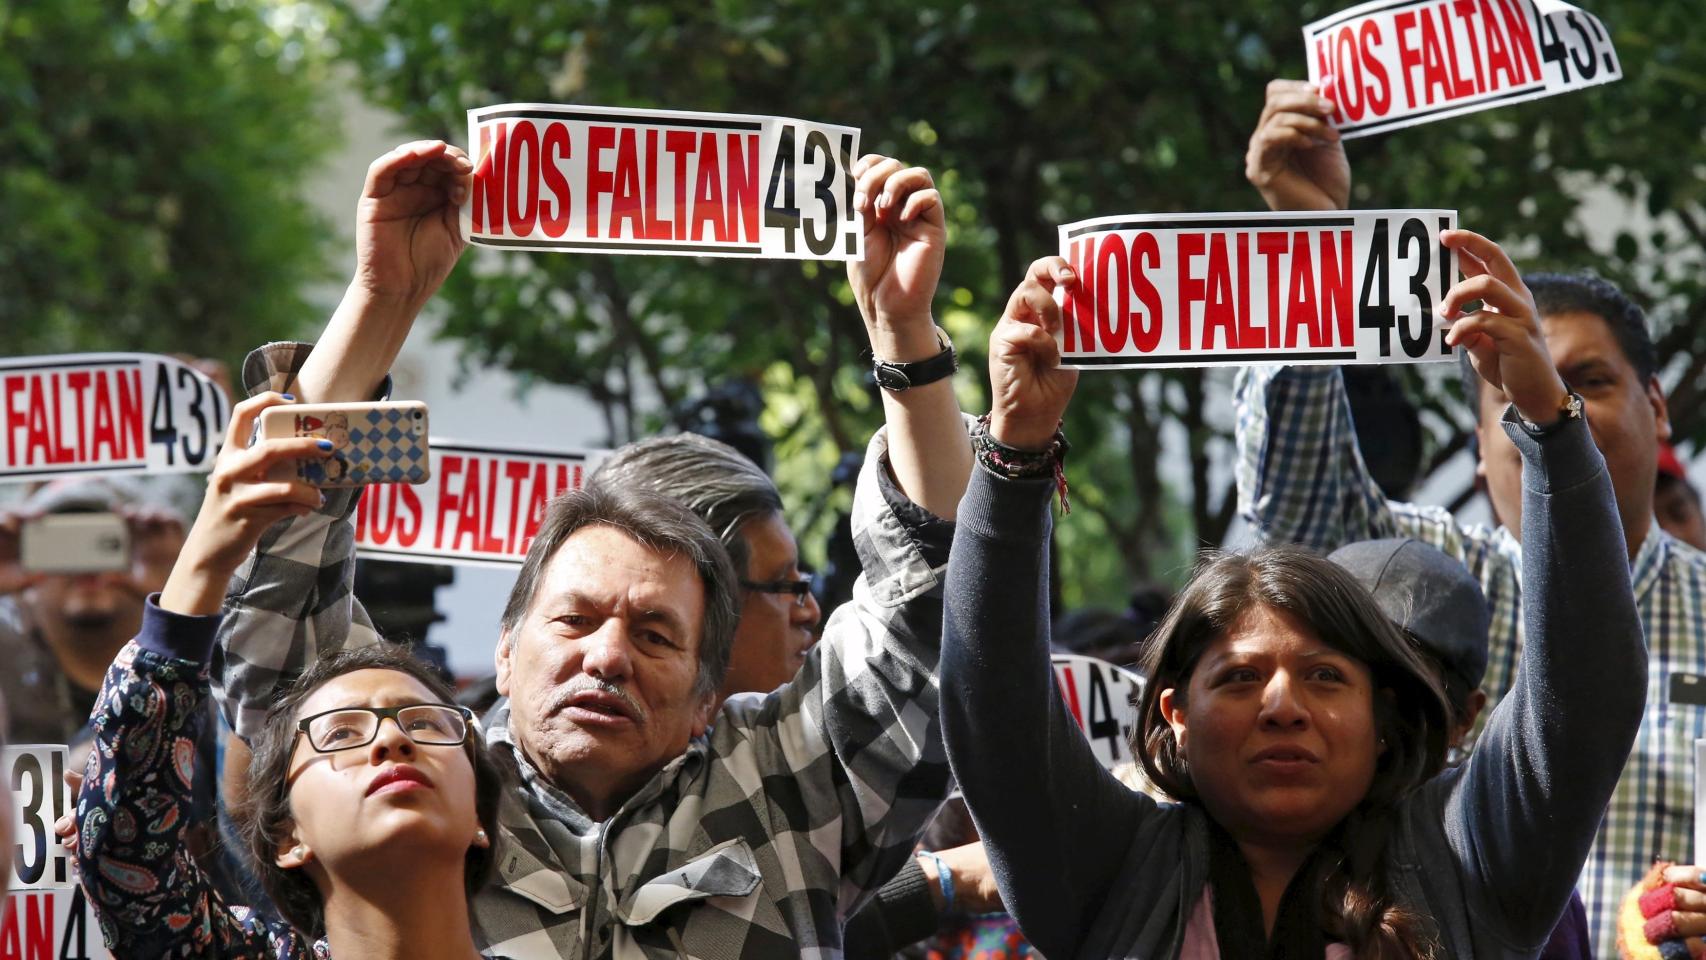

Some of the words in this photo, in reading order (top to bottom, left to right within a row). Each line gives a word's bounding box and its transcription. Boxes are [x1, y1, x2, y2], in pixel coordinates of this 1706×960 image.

[1394, 0, 1542, 109] FALTAN
[471, 120, 571, 238] NOS
[586, 125, 760, 243] FALTAN
[764, 125, 858, 256] 43!
[1063, 231, 1163, 353] NOS
[1177, 230, 1354, 351] FALTAN
[5, 368, 145, 467] FALTAN
[150, 362, 224, 466] 43!
[434, 455, 583, 555] FALTA
